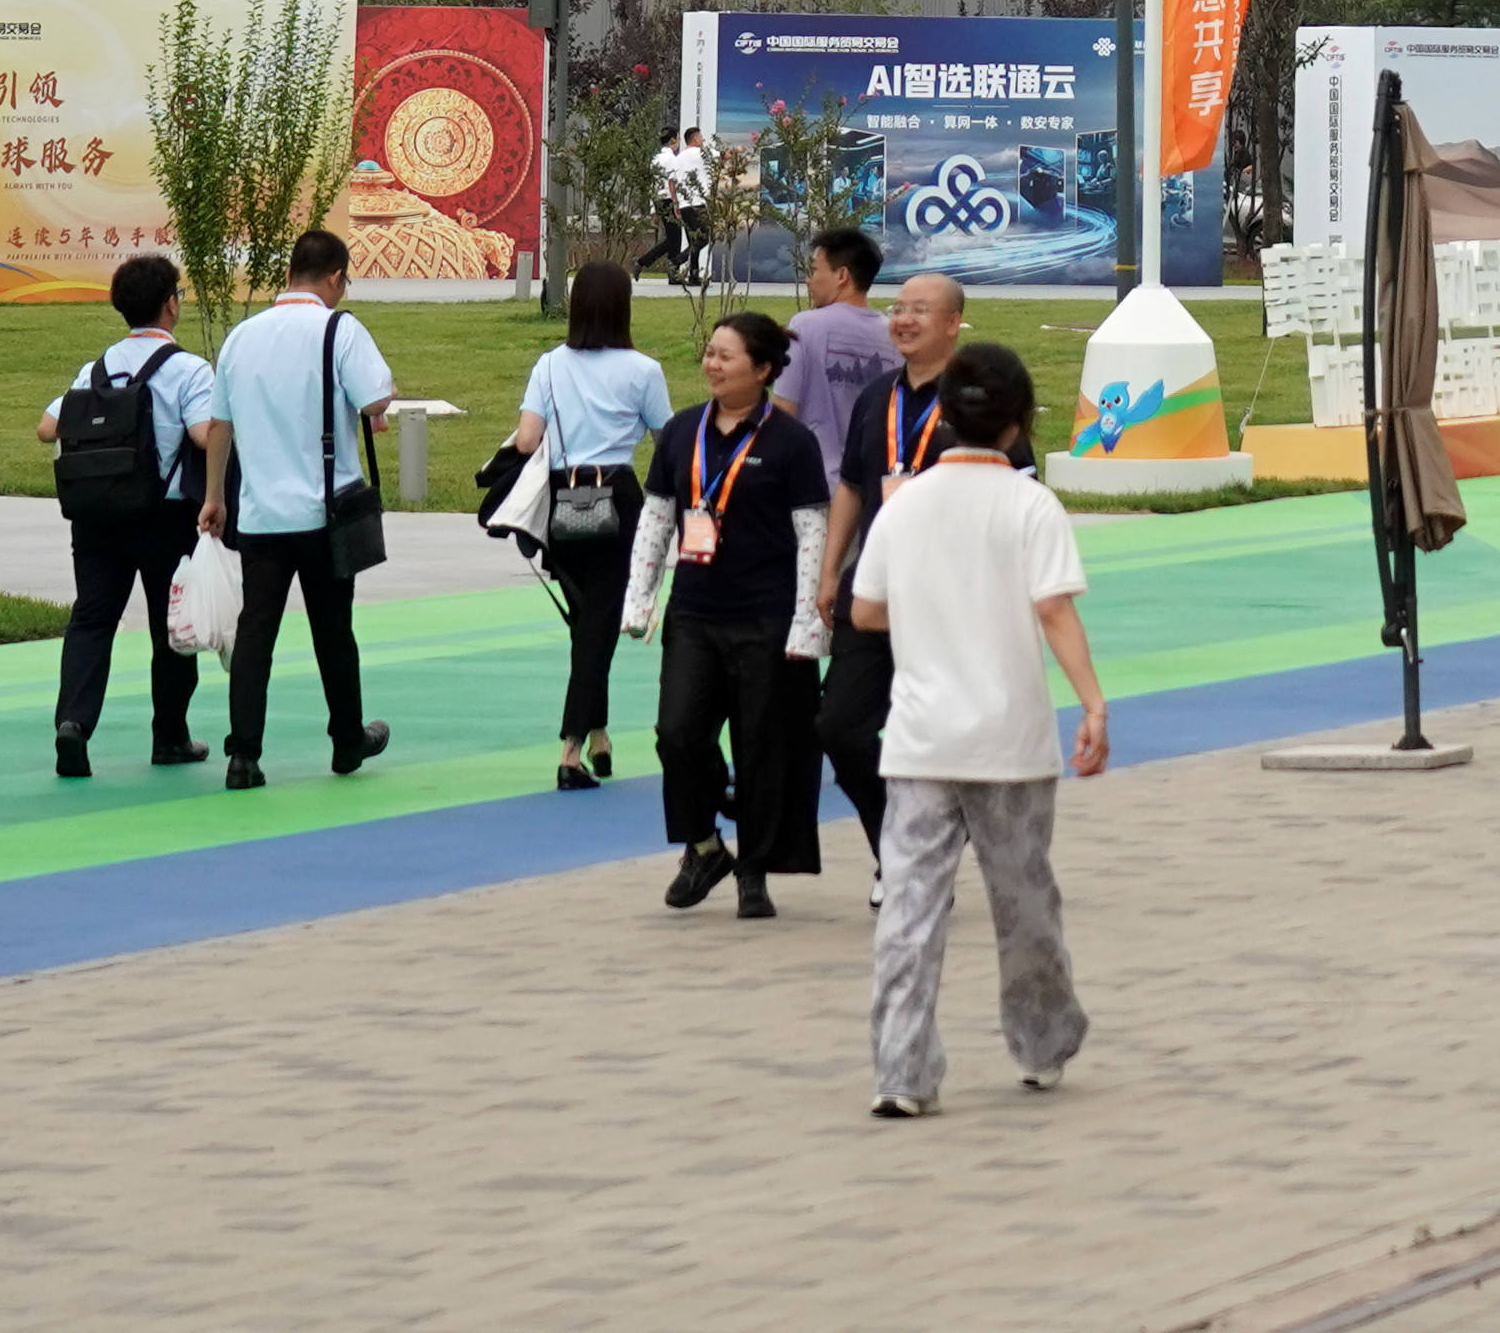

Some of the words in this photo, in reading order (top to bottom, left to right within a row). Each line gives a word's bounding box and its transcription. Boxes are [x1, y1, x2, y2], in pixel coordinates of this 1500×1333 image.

[766, 36, 899, 49] 中国国际服务贸易交易会
[866, 63, 1076, 100] AI智选联通云
[2, 115, 60, 124] TECHNOLOGIES
[866, 114, 921, 130] 智能融合
[944, 114, 998, 130] 算网一体
[1020, 114, 1075, 130] 数安专家
[57, 182, 73, 190] YOU
